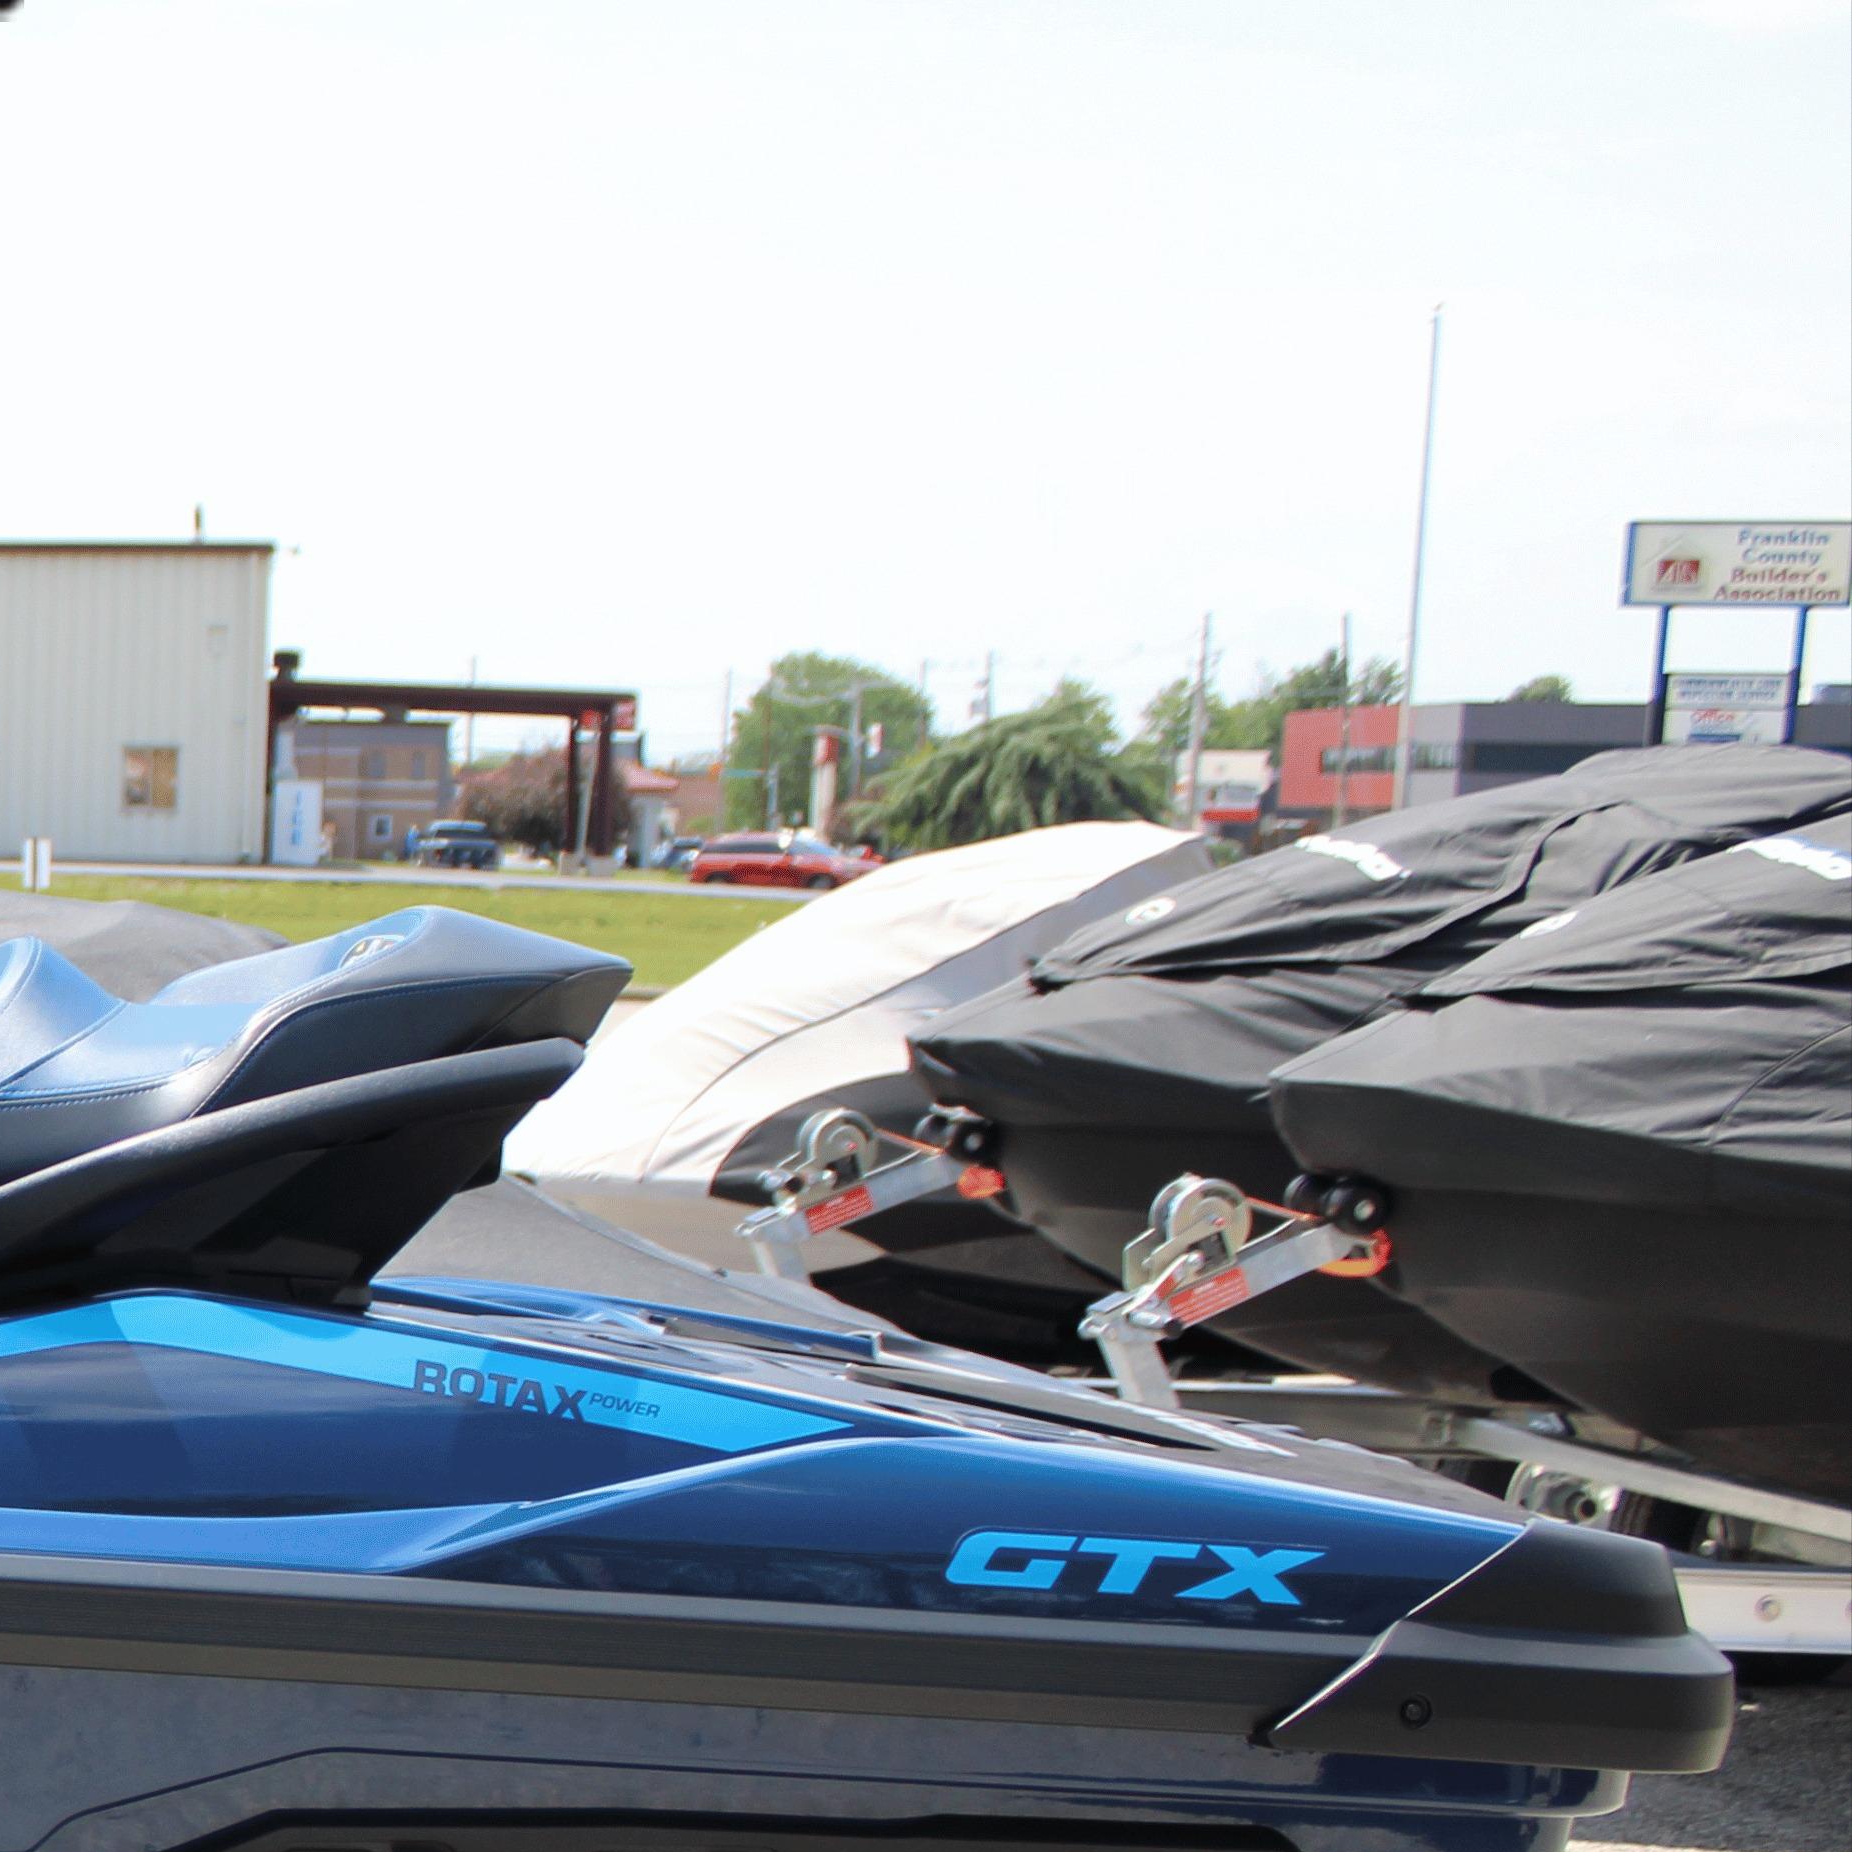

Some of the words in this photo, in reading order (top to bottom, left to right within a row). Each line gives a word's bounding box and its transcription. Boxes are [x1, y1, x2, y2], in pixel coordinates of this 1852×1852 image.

[1737, 527, 1831, 546] Franklin
[1742, 549, 1823, 566] County
[1730, 567, 1828, 584] Builder's
[1713, 585, 1841, 601] Association
[413, 1359, 588, 1425] ROTAX
[588, 1391, 661, 1419] POWER
[945, 1530, 1326, 1606] GTX
